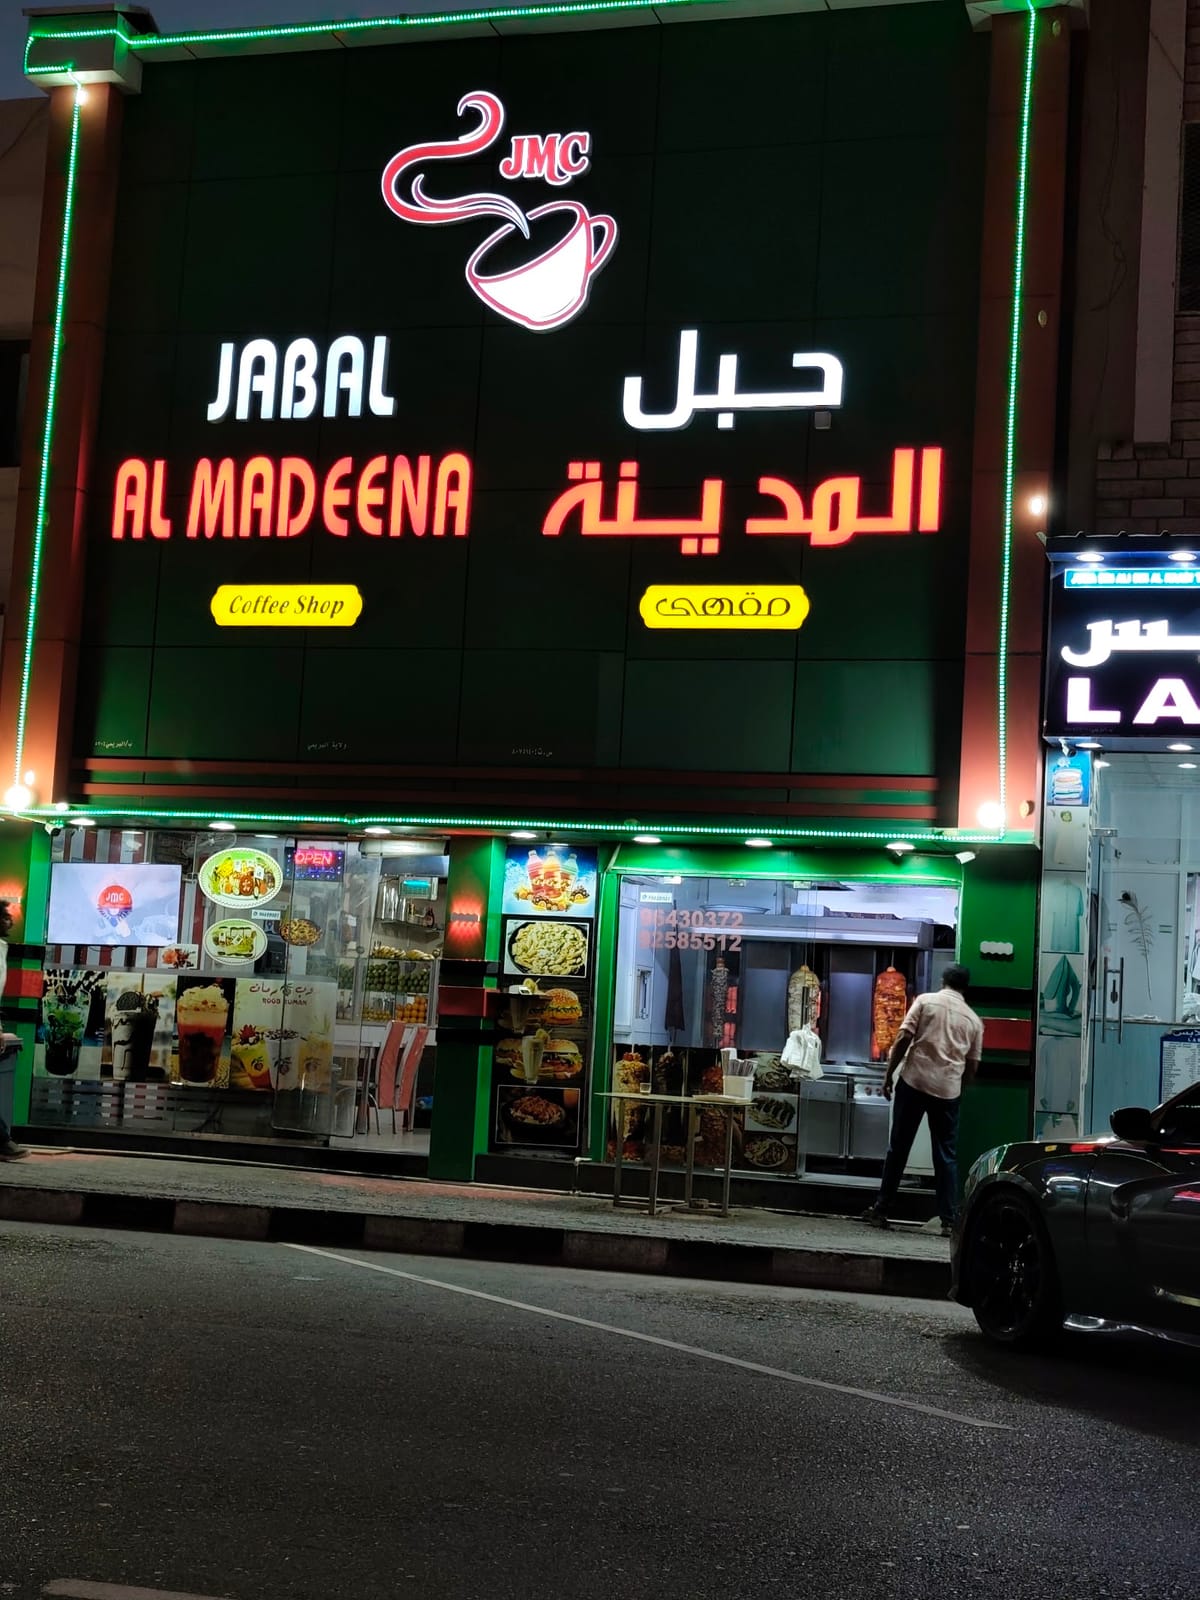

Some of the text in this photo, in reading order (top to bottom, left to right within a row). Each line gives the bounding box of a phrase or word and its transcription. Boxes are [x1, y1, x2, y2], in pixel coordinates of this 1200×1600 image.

[499, 131, 590, 186] JMC
[206, 335, 395, 421] JABAL
[622, 329, 844, 430] جبل
[111, 453, 472, 539] AL MADEENA
[541, 446, 943, 554] المدينة
[229, 594, 344, 619] Coffee Shop
[295, 852, 333, 865] OPEN
